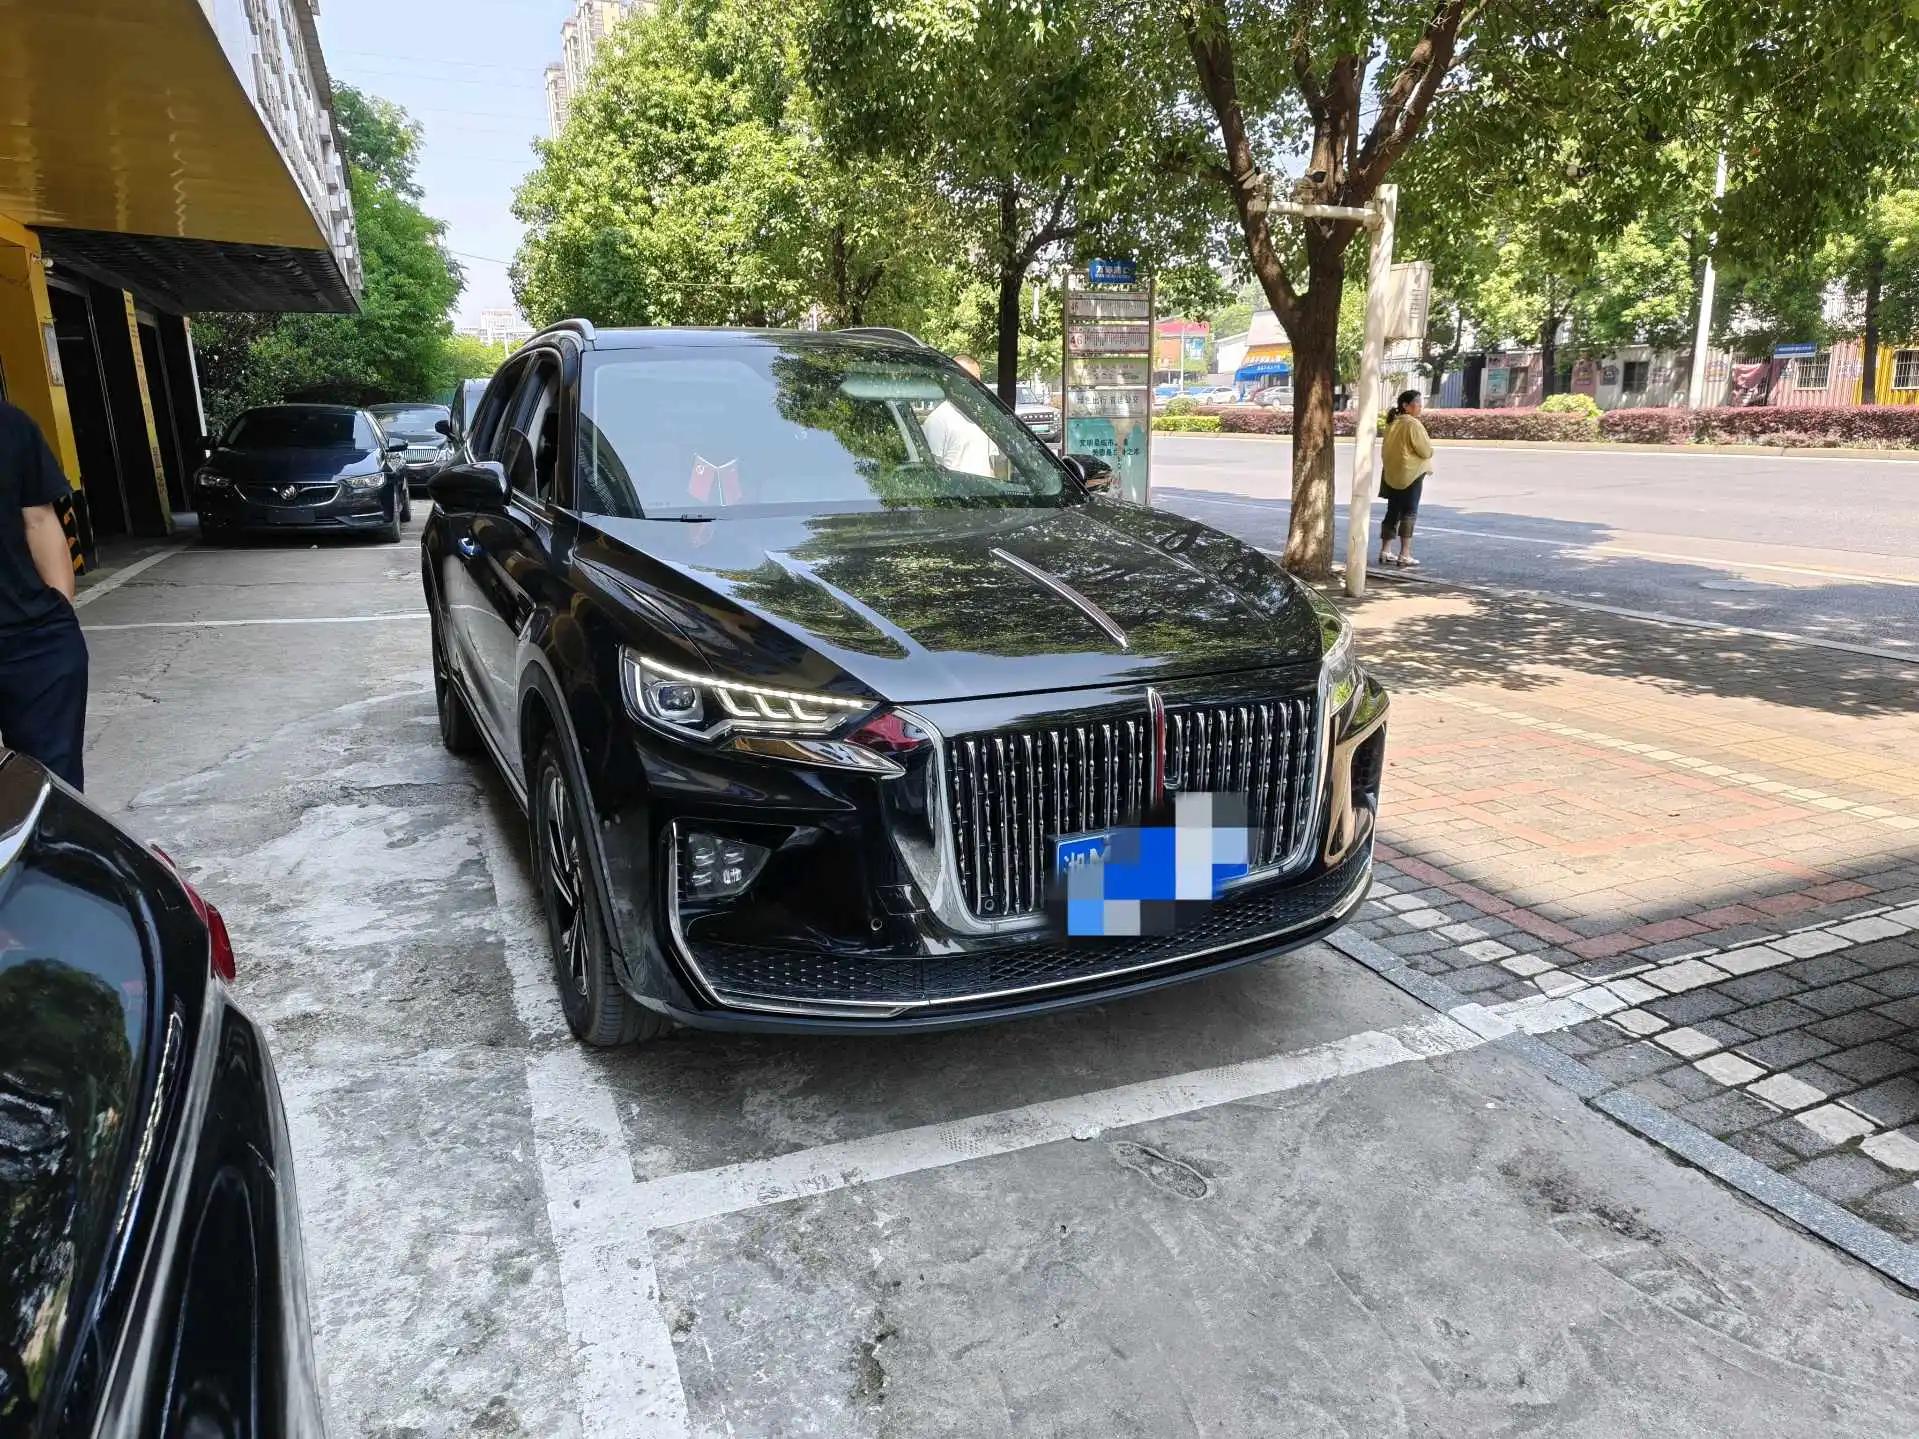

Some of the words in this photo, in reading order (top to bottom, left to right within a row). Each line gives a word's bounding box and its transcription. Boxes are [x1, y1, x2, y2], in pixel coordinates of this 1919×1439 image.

[1070, 335, 1083, 345] 46
[1079, 438, 1129, 447] 文明是城市
